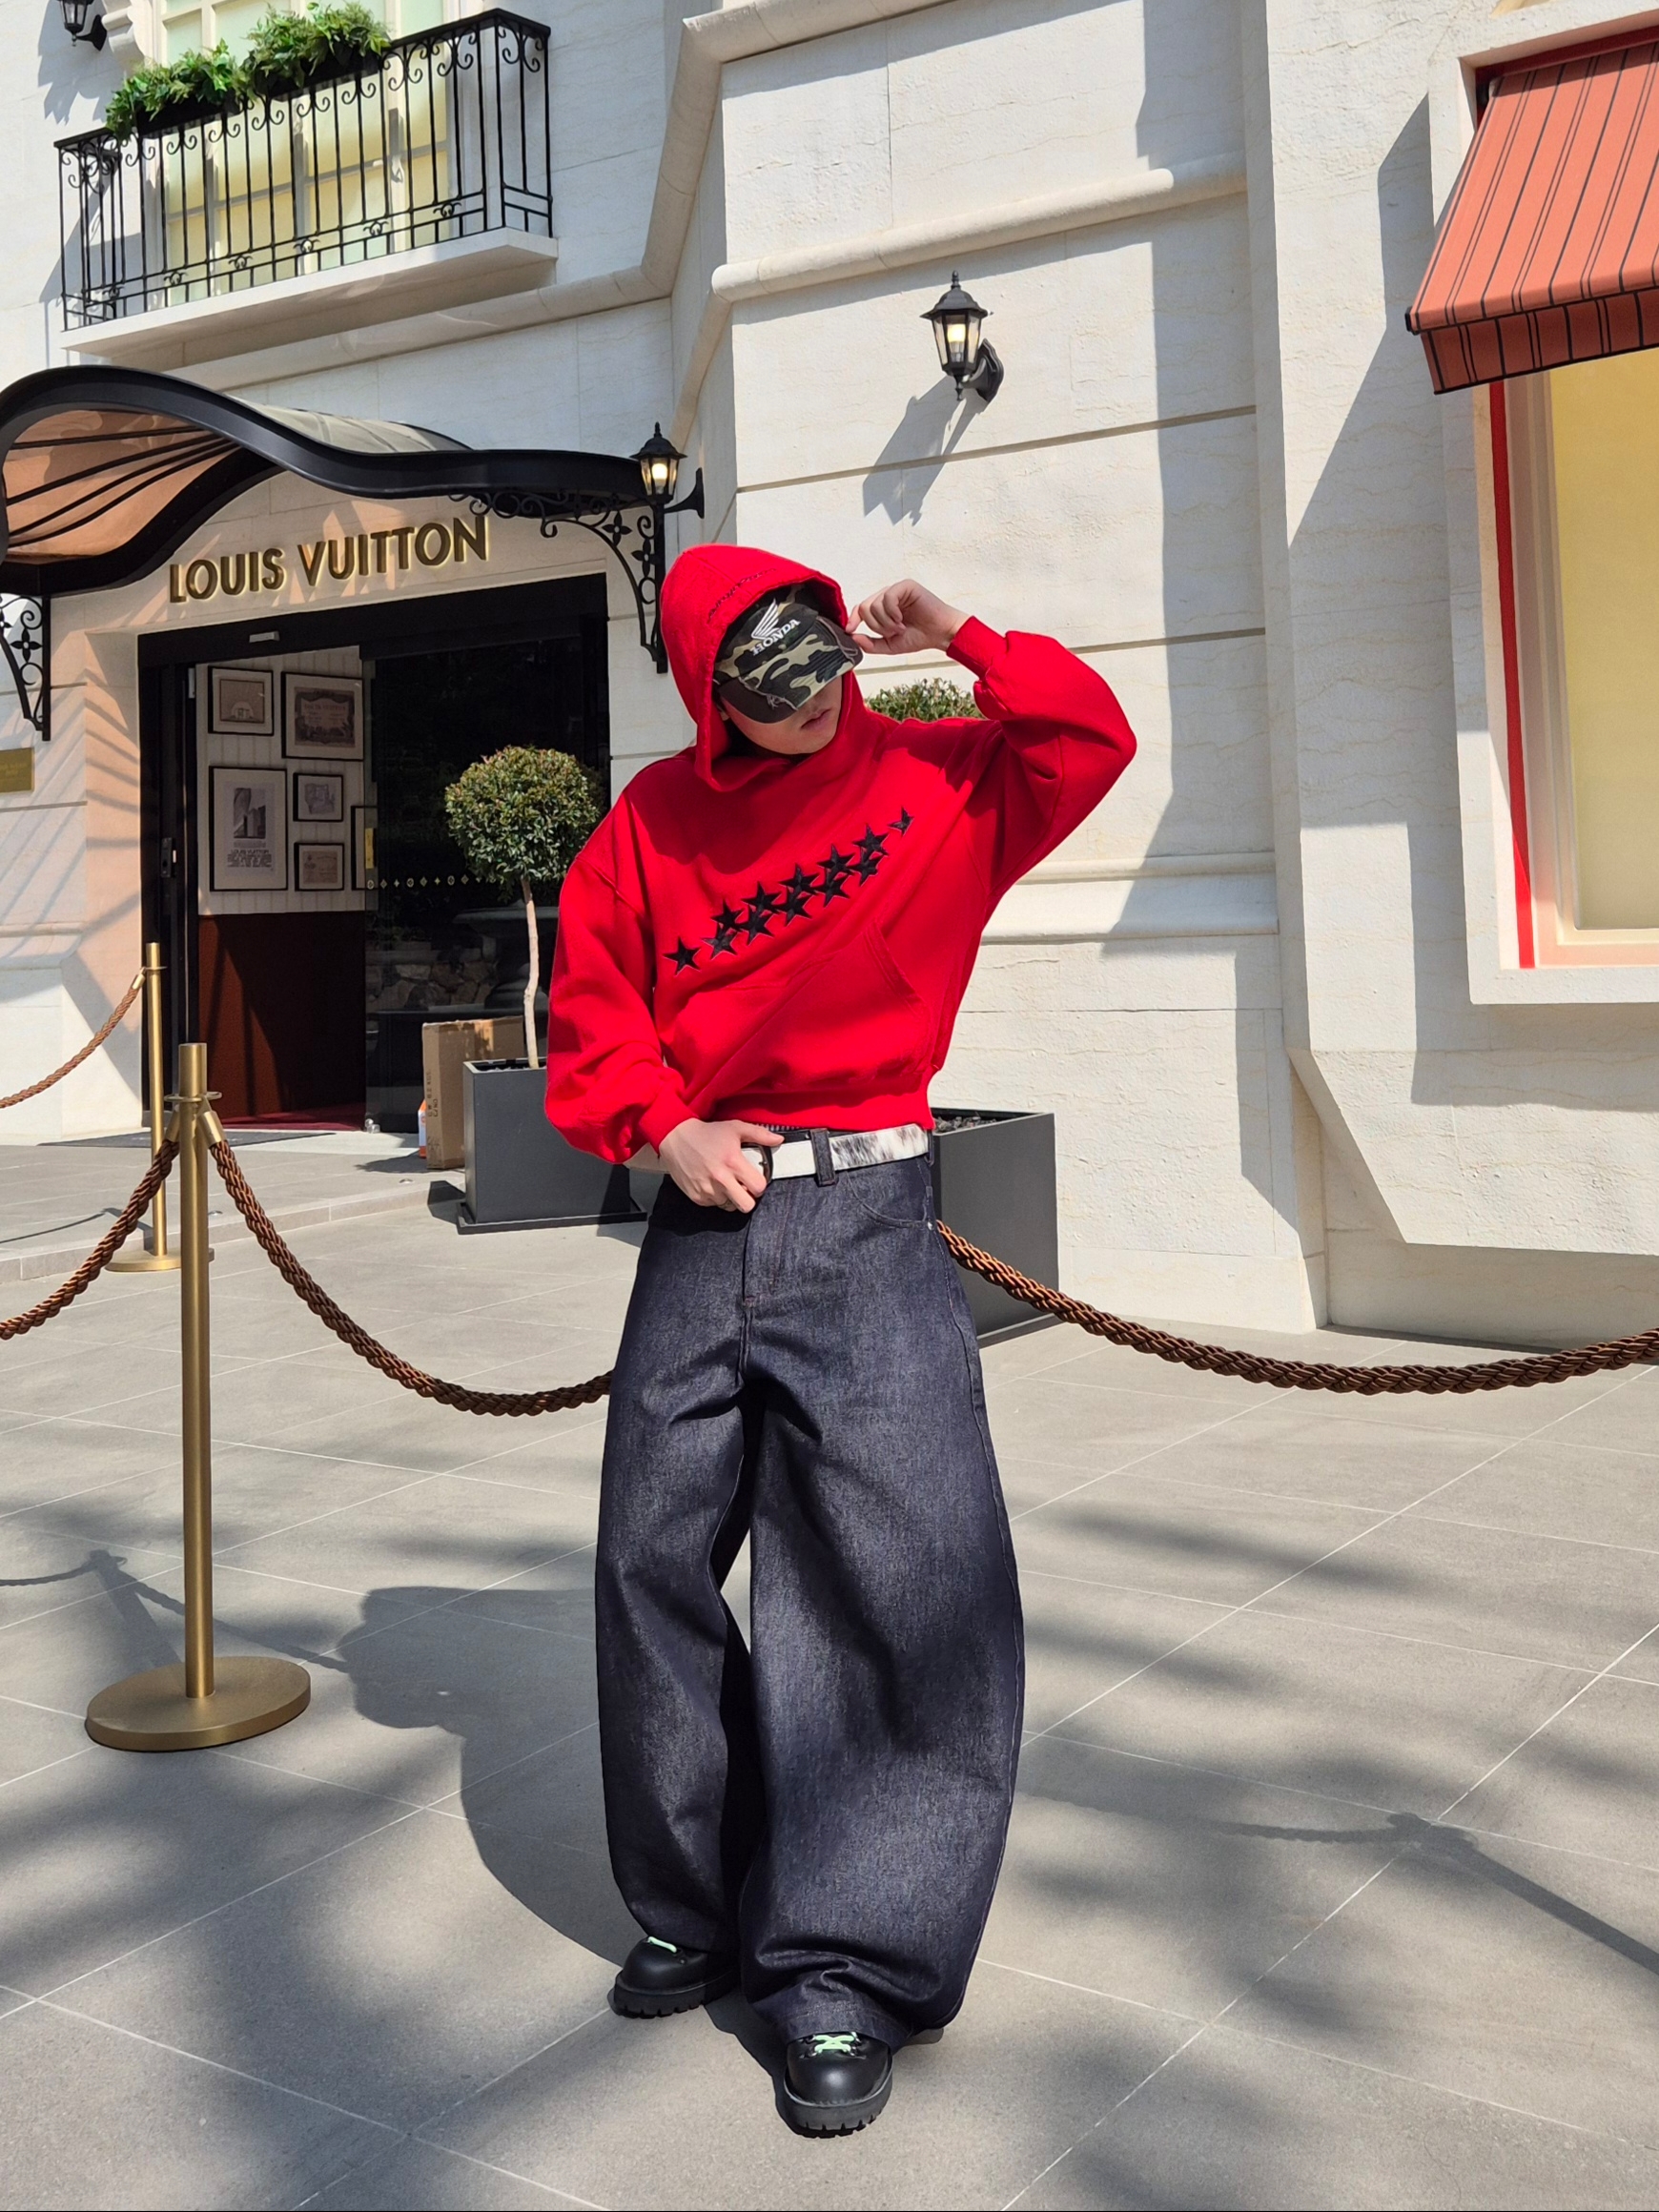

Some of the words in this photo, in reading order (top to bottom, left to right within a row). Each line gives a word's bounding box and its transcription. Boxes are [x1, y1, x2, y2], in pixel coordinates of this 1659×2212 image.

[170, 548, 284, 603] LOUIS
[297, 515, 488, 586] VUITTON
[750, 619, 801, 656] HONDA
